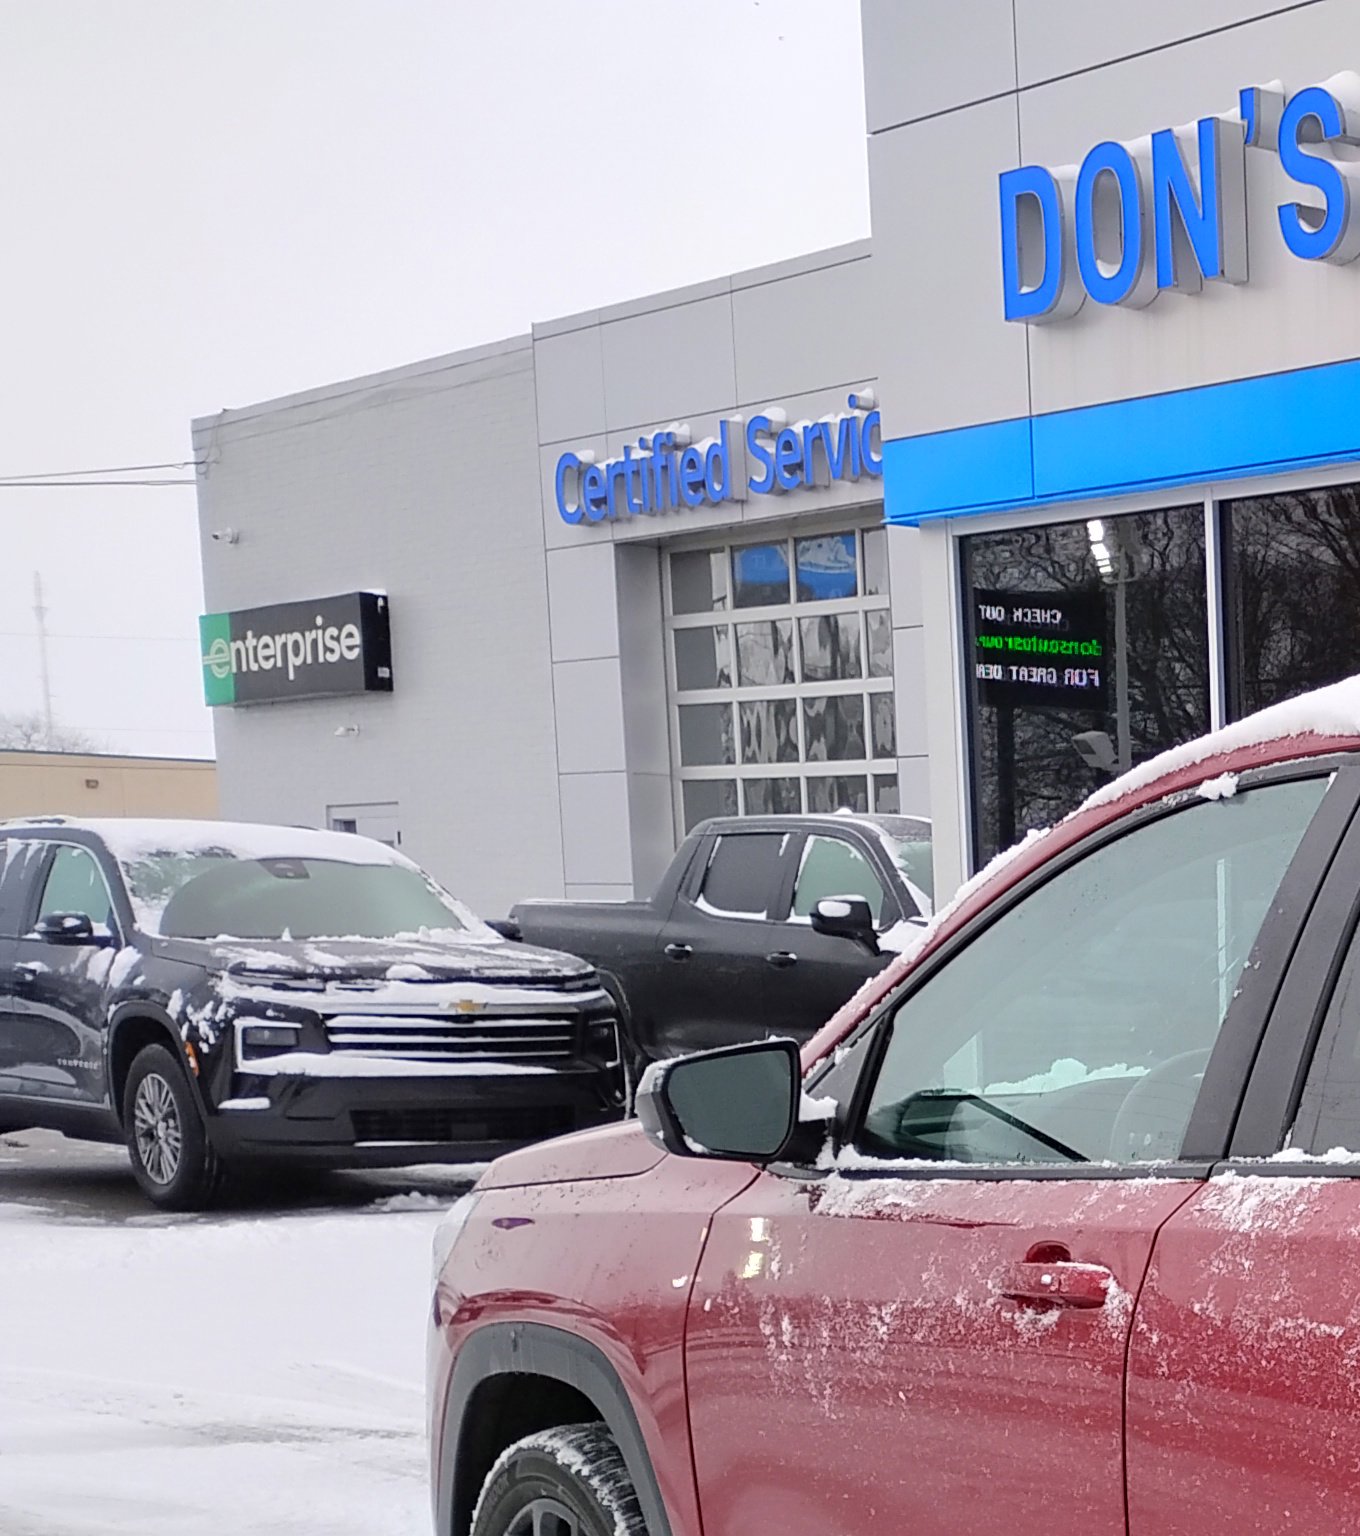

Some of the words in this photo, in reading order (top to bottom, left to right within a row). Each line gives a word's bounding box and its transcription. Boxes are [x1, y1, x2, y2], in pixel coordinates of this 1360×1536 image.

[998, 82, 1352, 322] DON'S
[555, 419, 732, 526] Certified
[204, 615, 361, 681] enterprise
